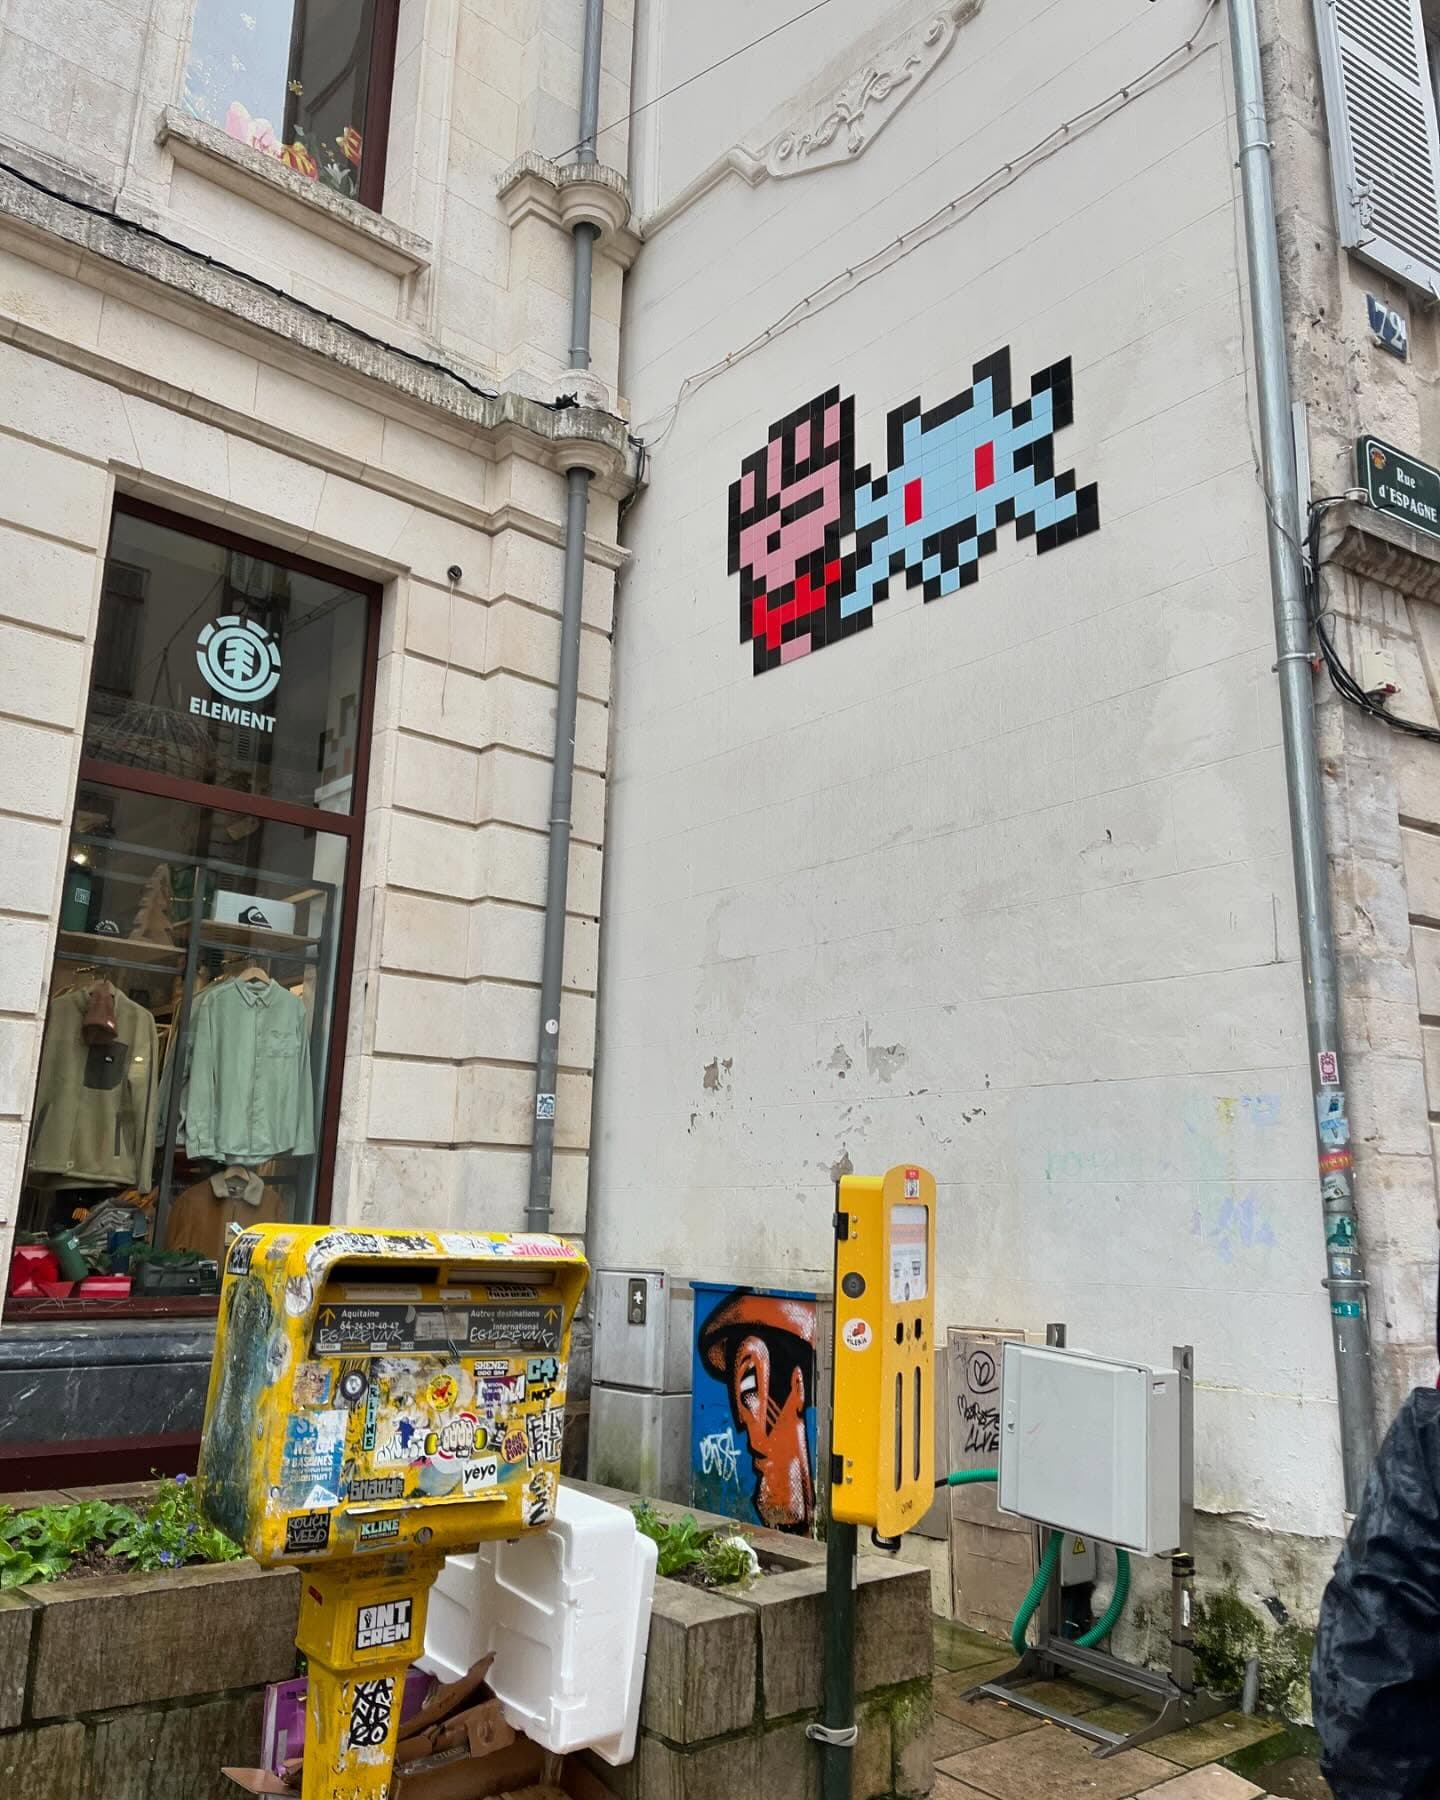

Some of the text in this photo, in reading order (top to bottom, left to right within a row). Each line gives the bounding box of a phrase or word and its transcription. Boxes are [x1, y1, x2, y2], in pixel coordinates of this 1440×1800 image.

[1396, 466, 1416, 489] Rue
[1378, 484, 1438, 523] d'ESPAGNE
[189, 696, 277, 733] ELEMENT
[341, 1309, 380, 1319] Aquitaine
[496, 1309, 540, 1318] destinations
[492, 1323, 540, 1332] International
[464, 1463, 497, 1485] yeyo
[361, 1519, 399, 1535] KLINE
[357, 1622, 410, 1649] CREW
